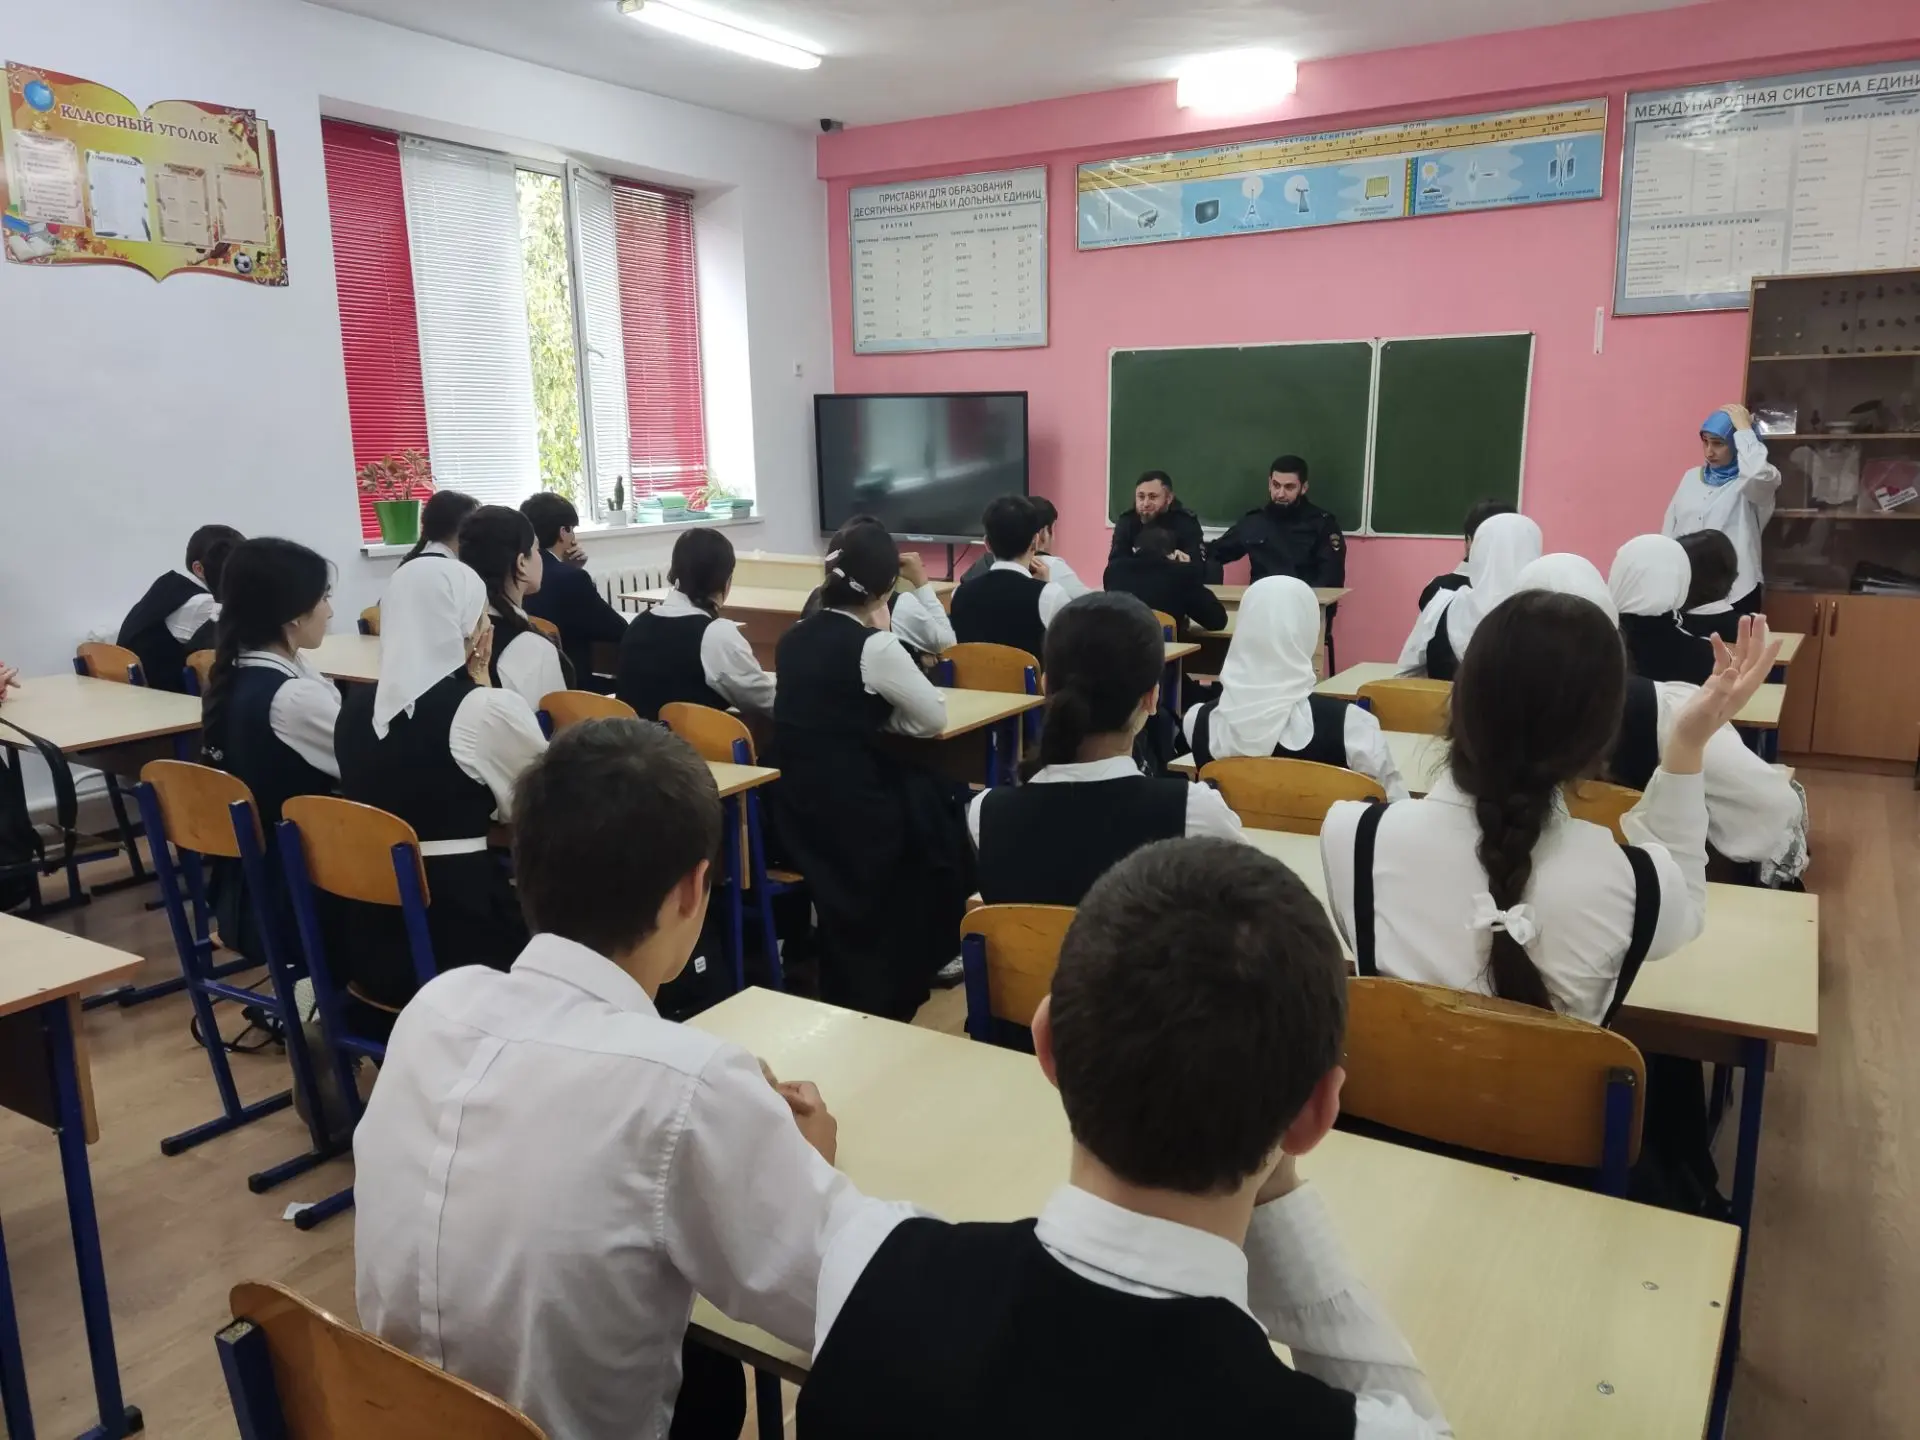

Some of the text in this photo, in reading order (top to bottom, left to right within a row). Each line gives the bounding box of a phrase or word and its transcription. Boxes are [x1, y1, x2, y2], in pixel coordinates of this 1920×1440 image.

[1634, 91, 1777, 118] МЕЖДУНАРОДНАЯ
[1783, 80, 1862, 101] СИСТЕМА
[60, 104, 220, 145] КЛАССНЫЙ УГОЛОК
[853, 188, 1042, 218] ДЕСЯТИЧНЫХ КРАТНЫХ И ДОЛЬНЫХ ЕДИНИЦ
[879, 180, 1013, 204] ПРИСТАВКИ ДЛЯ ОБРАЗОВАНИЯ
